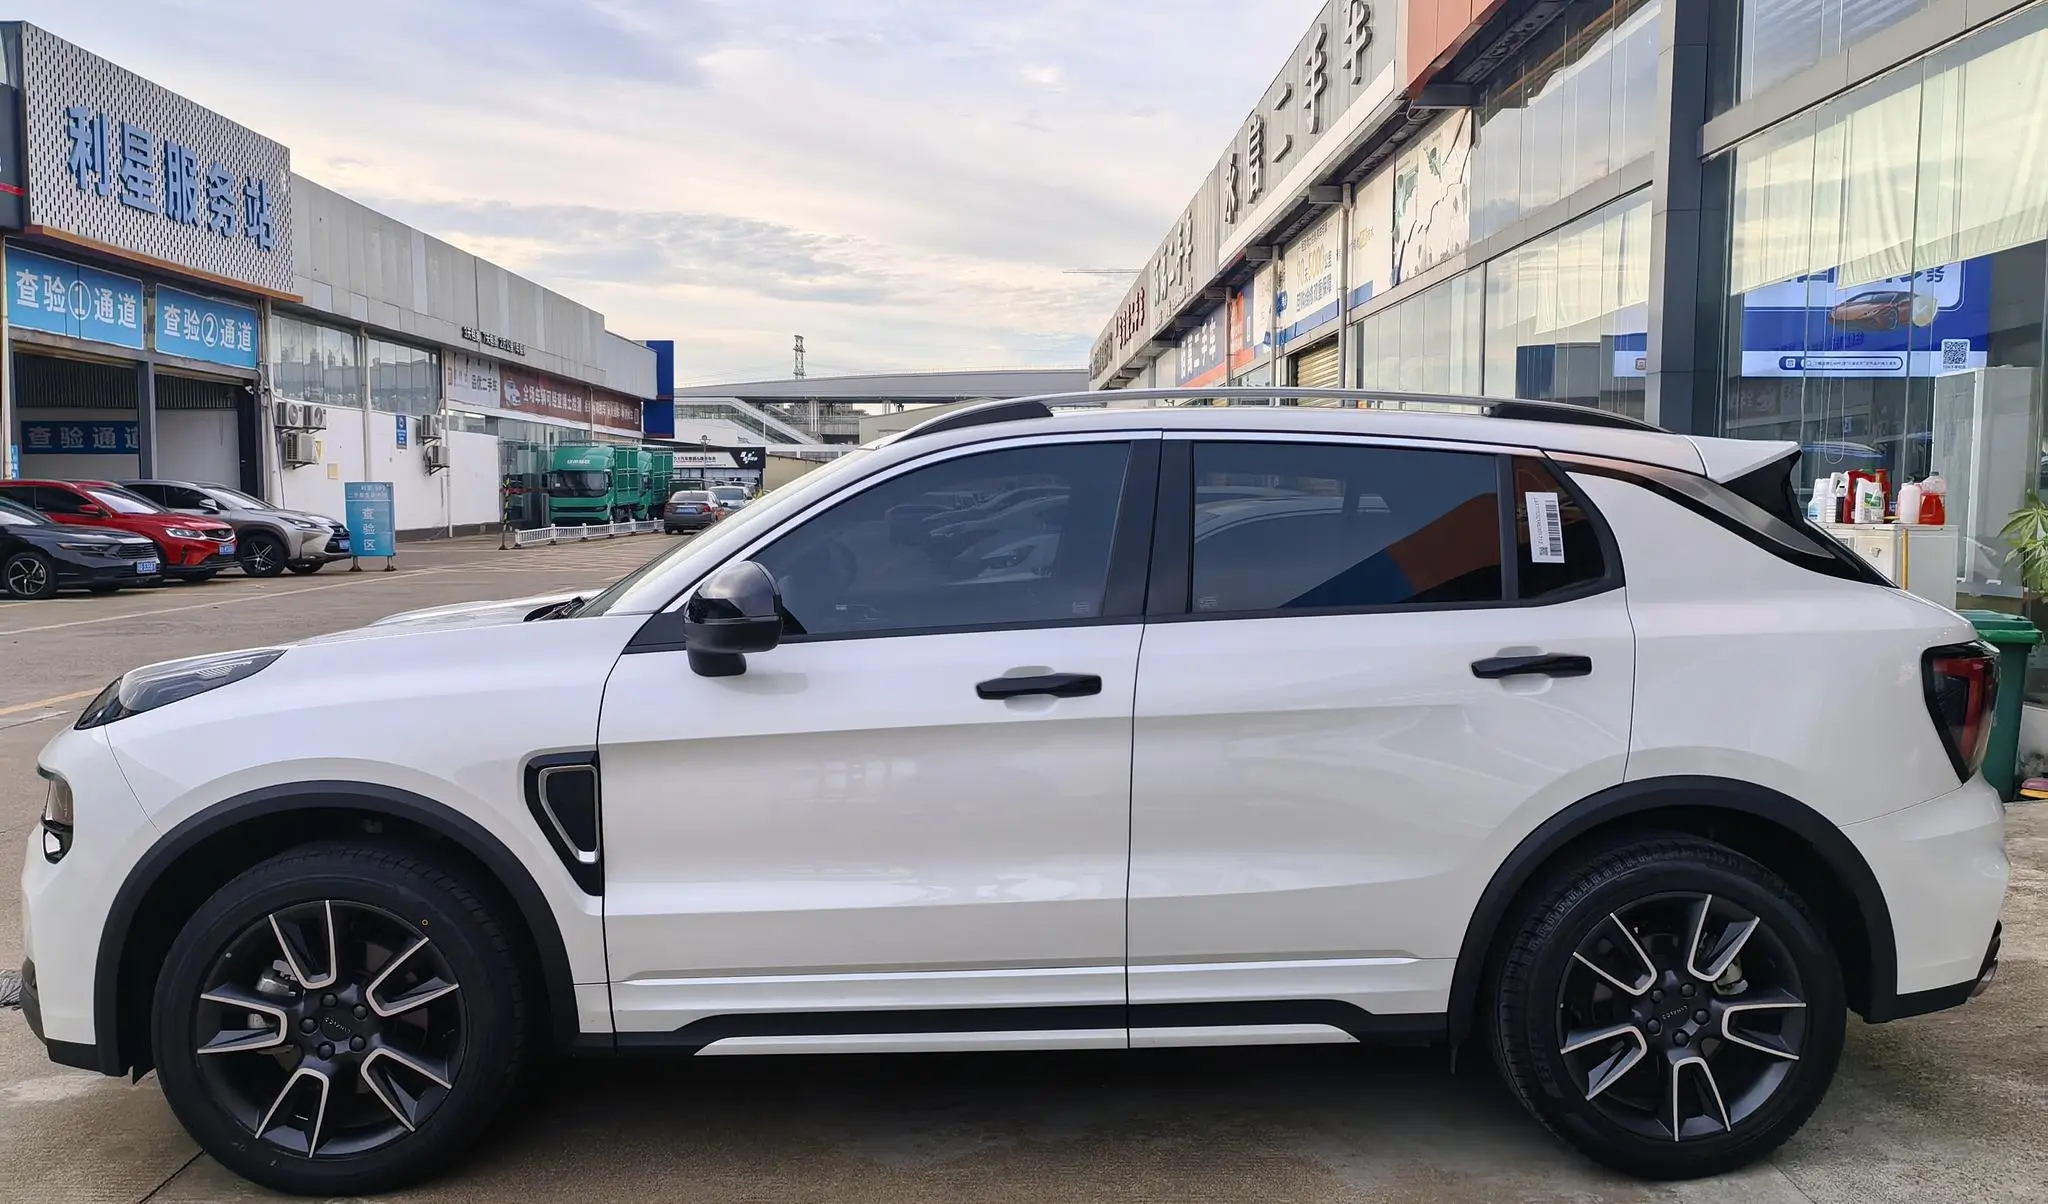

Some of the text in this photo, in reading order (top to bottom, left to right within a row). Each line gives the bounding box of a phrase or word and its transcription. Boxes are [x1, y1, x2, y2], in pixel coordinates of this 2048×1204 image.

[64, 105, 275, 252] 利星服务站
